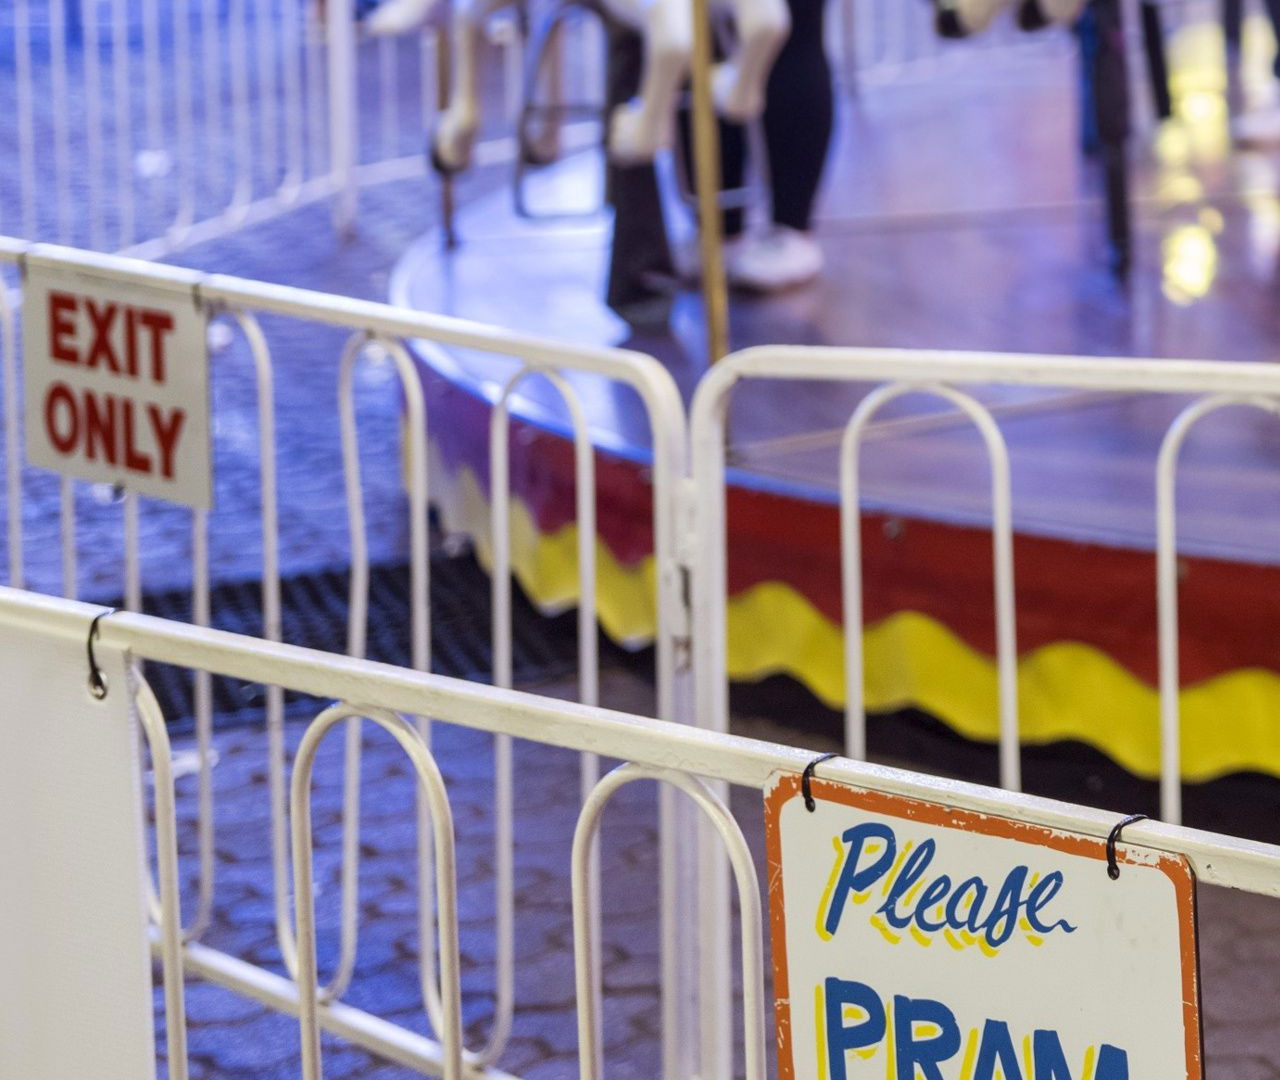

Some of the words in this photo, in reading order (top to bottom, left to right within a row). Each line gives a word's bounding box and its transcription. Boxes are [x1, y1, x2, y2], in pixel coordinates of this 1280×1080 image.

[48, 291, 175, 384] EXIT
[44, 381, 186, 481] ONLY
[817, 823, 1077, 954] Please
